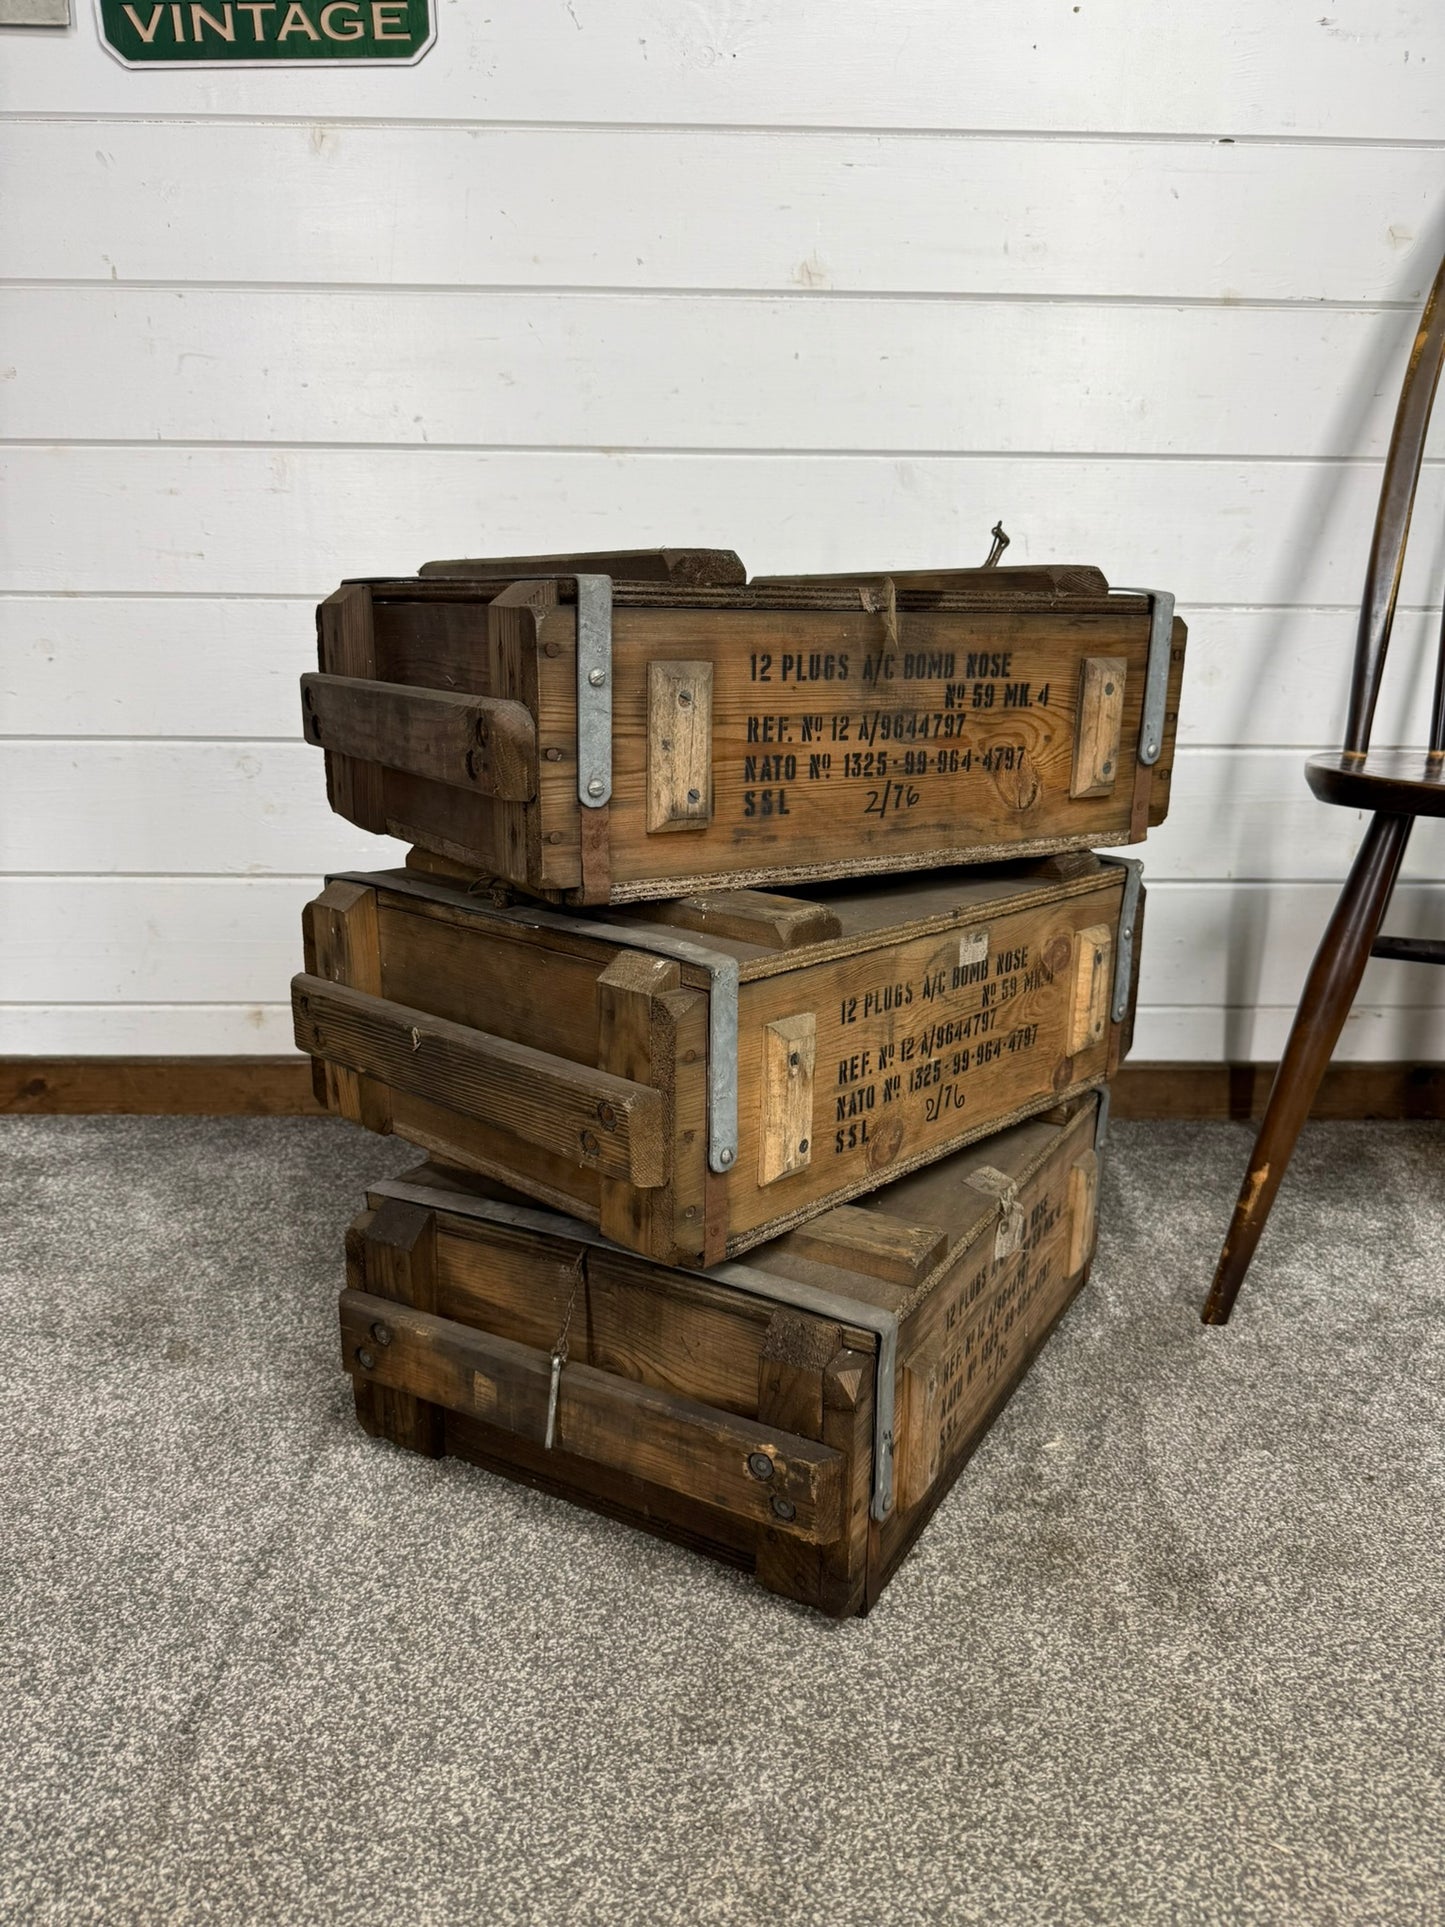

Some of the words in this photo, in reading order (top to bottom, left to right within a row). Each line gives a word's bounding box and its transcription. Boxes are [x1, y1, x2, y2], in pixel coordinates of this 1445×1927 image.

[121, 1, 412, 42] VINTAGE
[750, 653, 772, 681] 12
[782, 653, 849, 681] PLUGS
[862, 649, 896, 688] A/C
[966, 652, 1013, 679] NOSE
[972, 683, 995, 708] 59
[1004, 683, 1033, 707] MK.
[1037, 682, 1050, 707] 4
[747, 715, 792, 743] REF.
[831, 715, 850, 741] 12
[744, 754, 797, 782] NATO
[744, 789, 790, 817] SSL
[864, 779, 920, 819] 2/76
[841, 998, 857, 1025] 12
[863, 984, 914, 1018] PLUGS
[922, 970, 947, 1004] A/C
[952, 958, 989, 990] BOMB
[996, 946, 1029, 976] NOSE
[1002, 976, 1017, 1000] 59
[838, 1052, 873, 1085] REF.
[900, 1036, 915, 1062] 12
[836, 1085, 875, 1122] NATO
[925, 1083, 966, 1122] 2/76
[835, 1120, 870, 1153] SSL
[945, 1303, 956, 1333] 12
[959, 1264, 987, 1316] PLUGS
